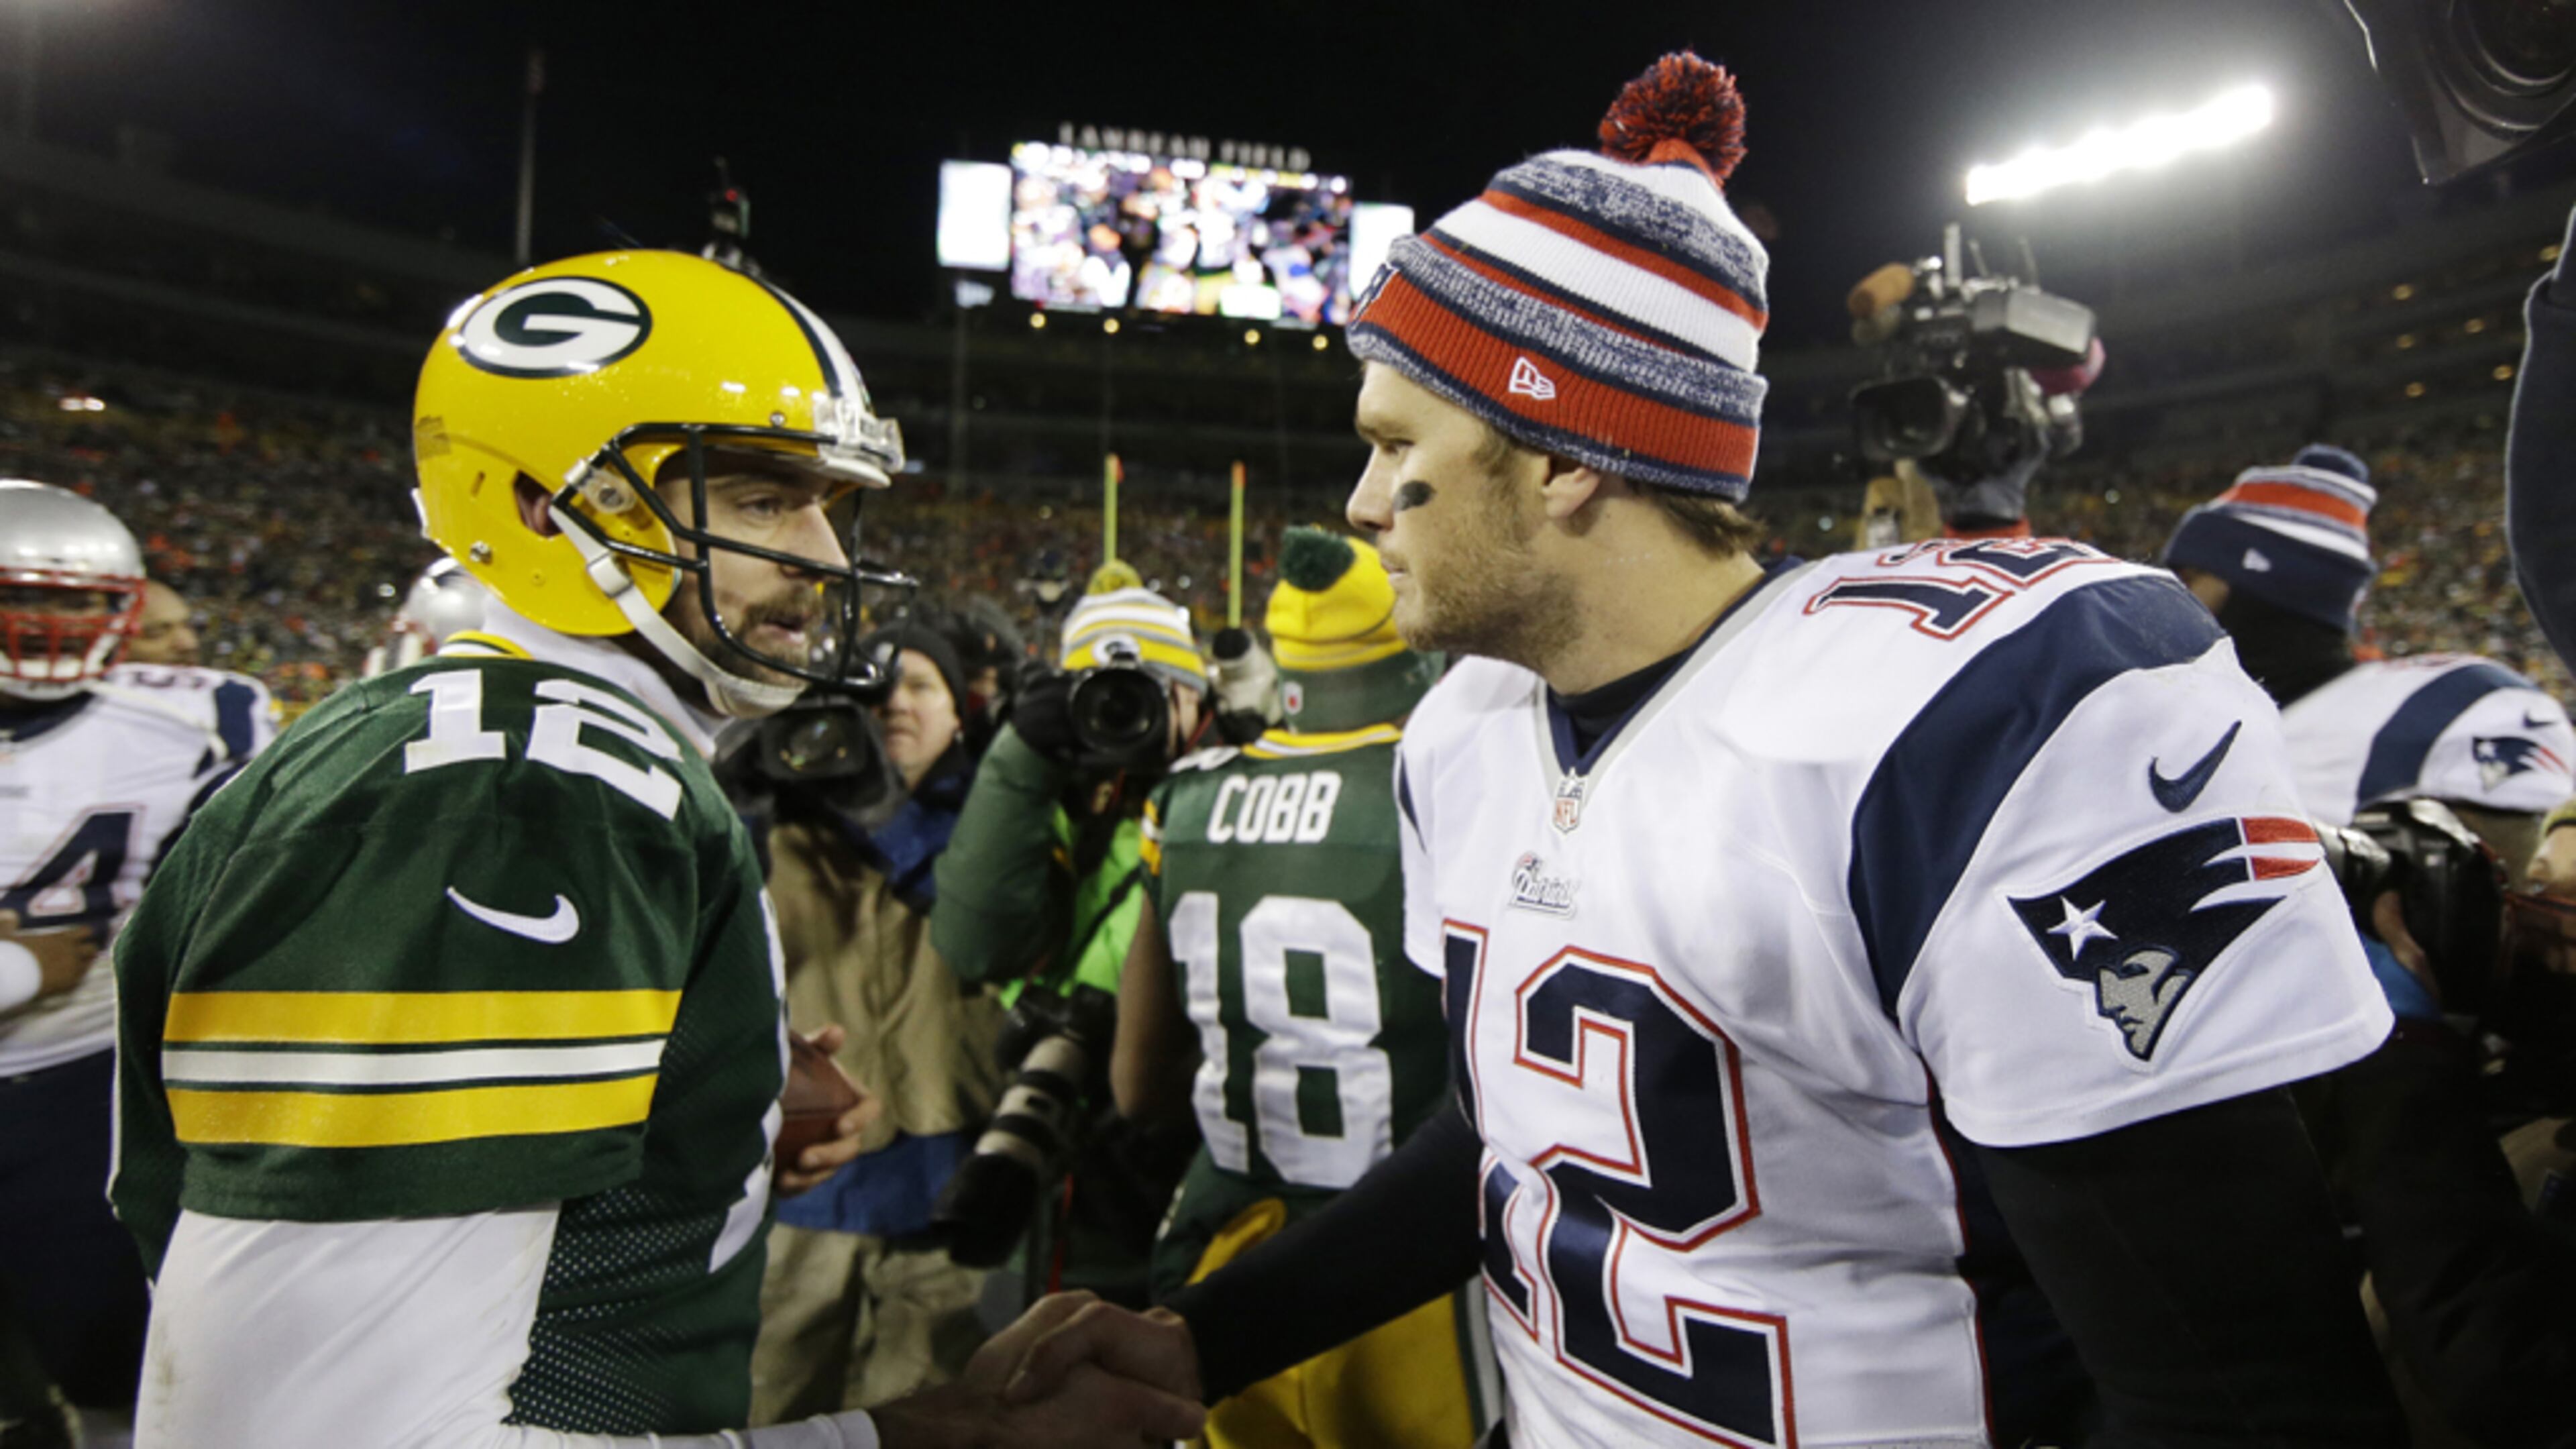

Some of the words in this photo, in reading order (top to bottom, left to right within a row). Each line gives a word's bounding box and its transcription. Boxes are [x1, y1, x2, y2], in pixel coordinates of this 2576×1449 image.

[459, 276, 652, 378] G
[405, 668, 684, 821] 12
[1208, 771, 1341, 844] COBB
[1169, 892, 1393, 1189] 18
[1442, 918, 1798, 1449] 12
